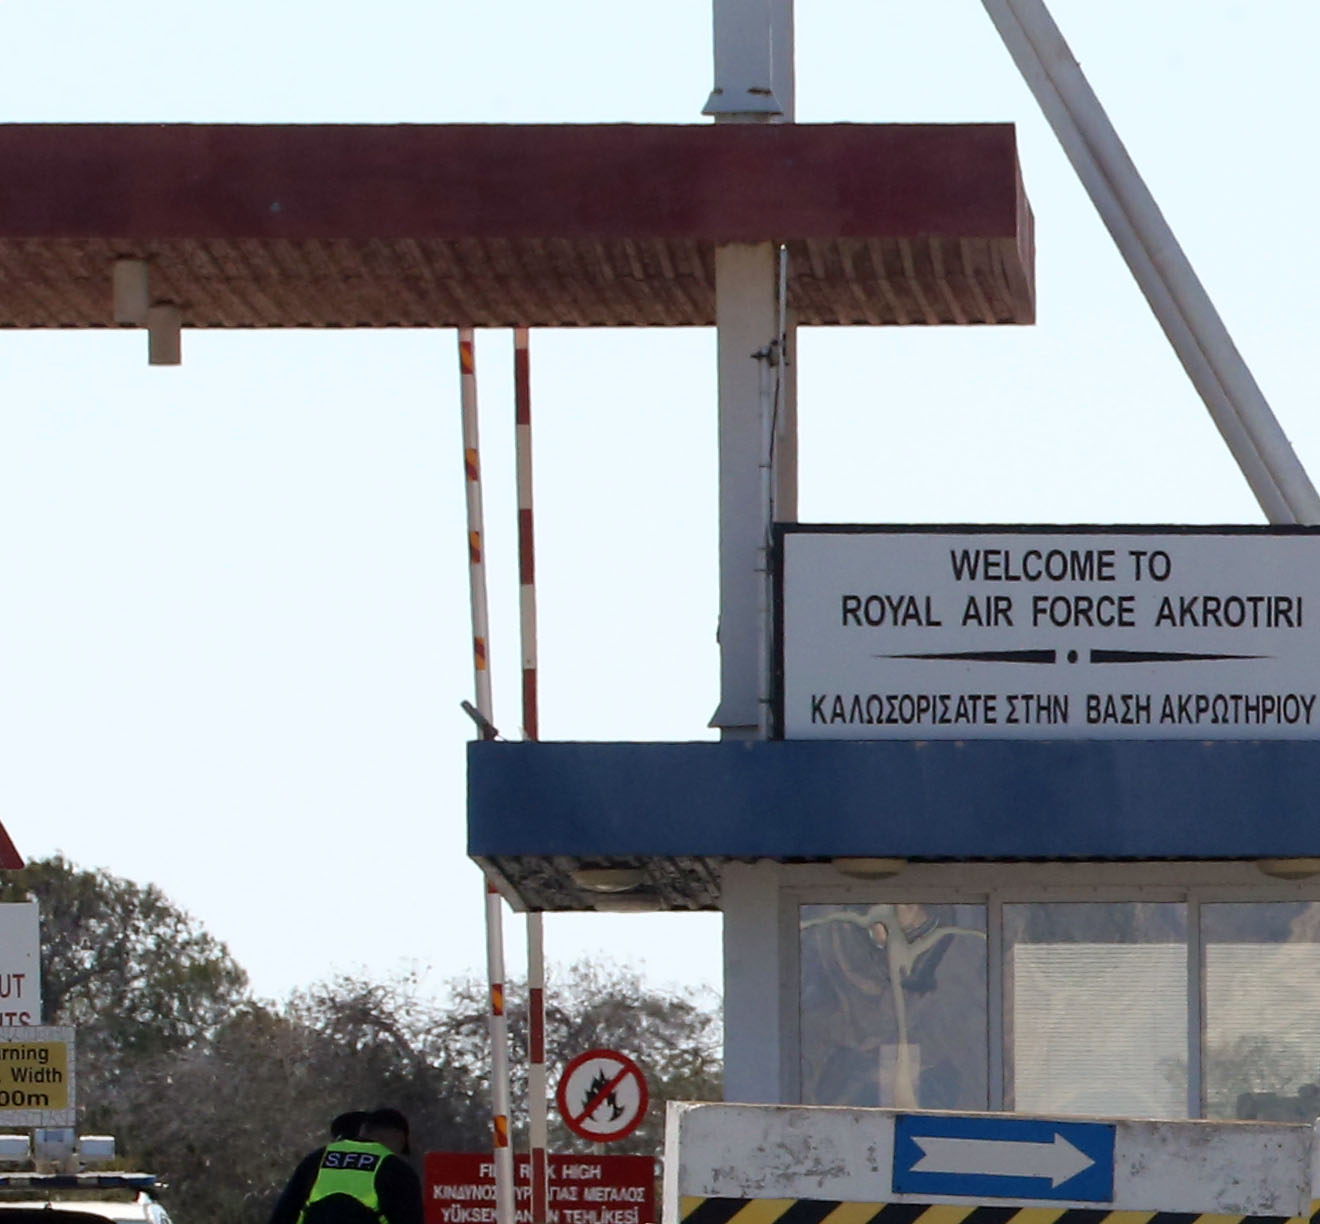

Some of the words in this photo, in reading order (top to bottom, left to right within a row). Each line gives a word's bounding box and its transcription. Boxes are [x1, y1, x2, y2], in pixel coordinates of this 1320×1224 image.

[951, 549, 1116, 582] WELCOME
[1129, 550, 1172, 582] TO
[841, 595, 942, 627] ROYAL
[961, 596, 1014, 627] AIR
[1032, 596, 1136, 628] FORCE
[1155, 597, 1303, 628] AKROTIRI
[811, 694, 997, 725] ΚΑΛΩΣΟΡΙΣΑΤΕ
[1005, 694, 1069, 725] ΣΤΗΝ
[1086, 694, 1151, 725] ΒΑΣΗ
[1159, 693, 1316, 725] ΑΚΡΩΤΗΡΙΟΥ
[0, 1045, 49, 1064] rning
[11, 1067, 62, 1083] Width
[563, 1165, 601, 1180] HIGH
